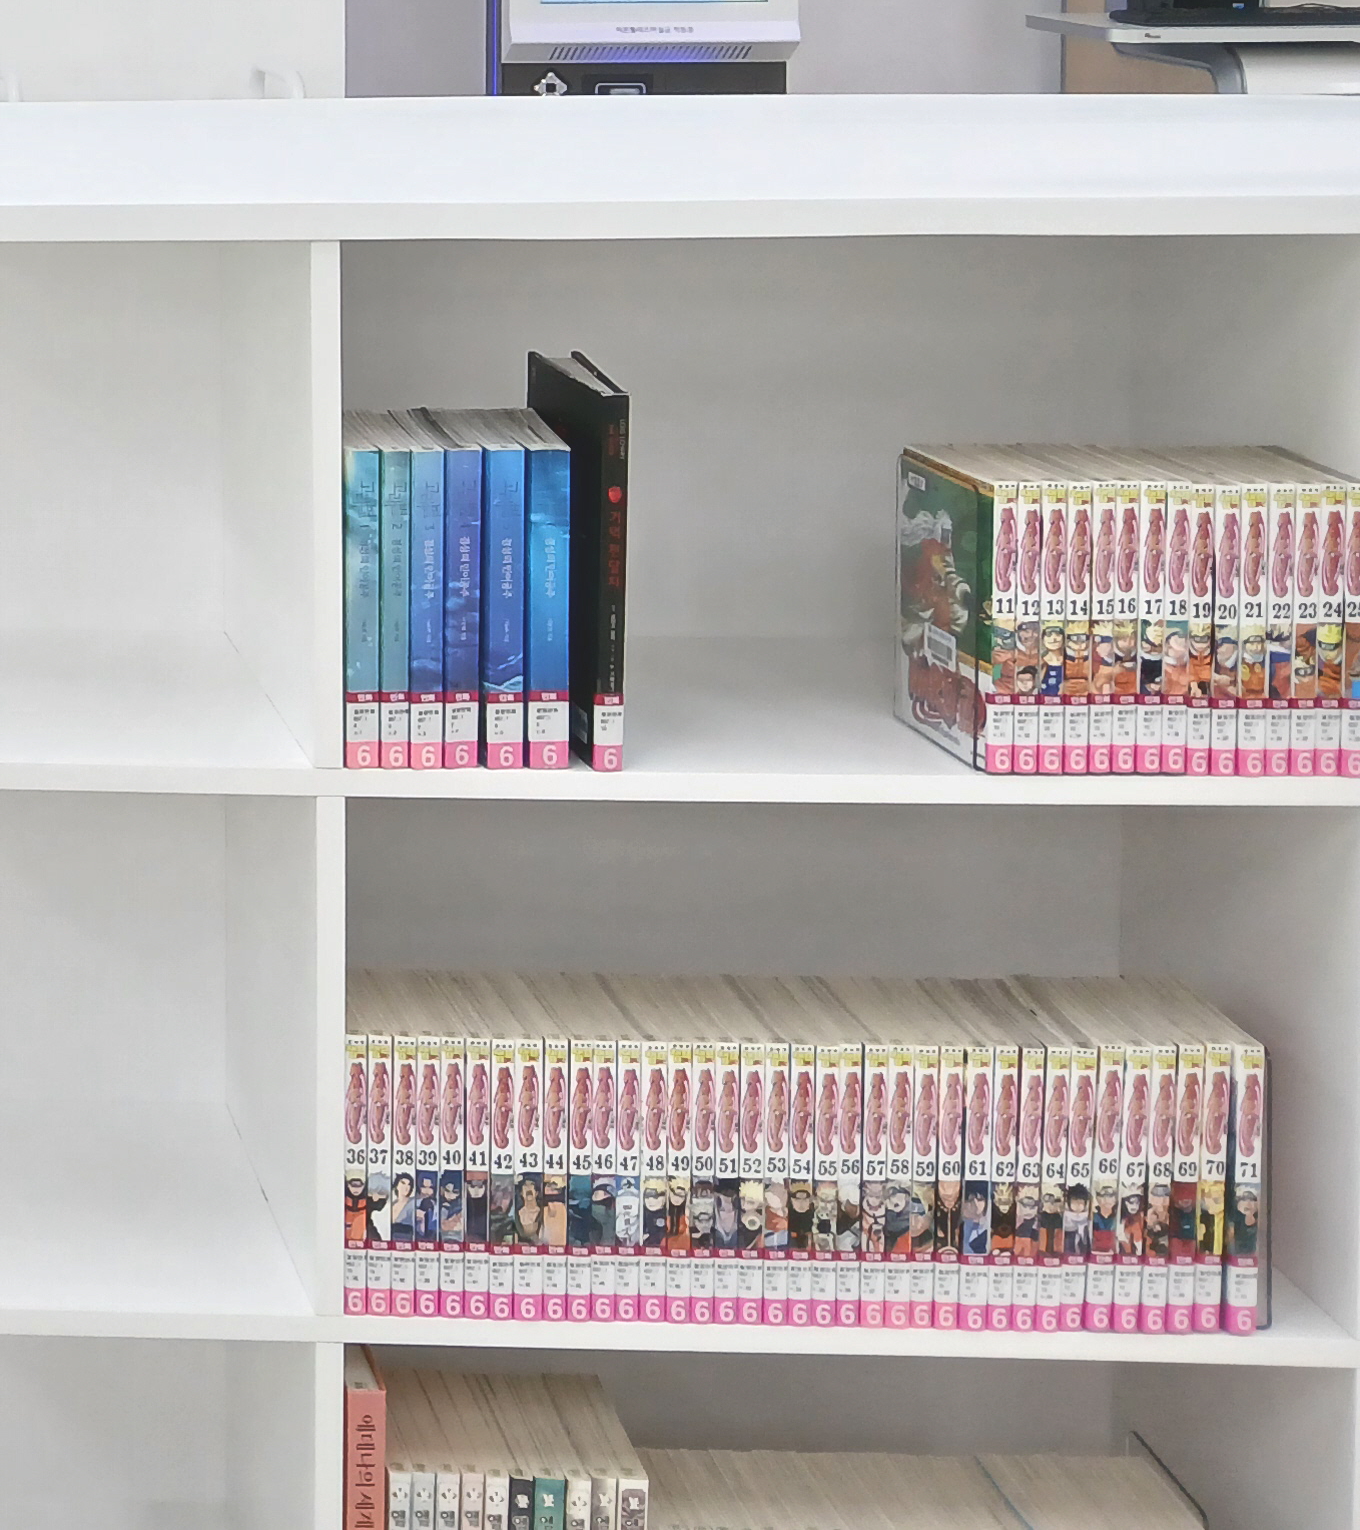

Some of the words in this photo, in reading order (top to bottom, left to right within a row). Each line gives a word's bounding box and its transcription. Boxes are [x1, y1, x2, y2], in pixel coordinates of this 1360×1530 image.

[996, 598, 1013, 613] 11
[1021, 600, 1040, 615] 12
[1046, 599, 1064, 614] 13
[1070, 600, 1088, 615] 14
[1097, 599, 1114, 614] 15
[1118, 598, 1136, 613] 16
[1145, 600, 1163, 615] 17
[1169, 600, 1187, 615] 18
[1192, 603, 1211, 618] 19
[1218, 604, 1237, 619] 20
[1245, 602, 1264, 617] 21
[1272, 603, 1291, 618] 22
[1298, 603, 1317, 618] 23
[1322, 602, 1342, 617] 24
[357, 745, 371, 766] 6
[500, 746, 514, 766] 6
[346, 1149, 365, 1164] 36
[395, 1150, 414, 1165] 38
[442, 1150, 461, 1165] 40
[493, 1154, 513, 1169] 42
[546, 1154, 565, 1169] 44
[594, 1154, 614, 1169] 46
[645, 1156, 665, 1171] 48
[694, 1157, 714, 1172] 50
[742, 1158, 762, 1173] 52
[792, 1160, 811, 1175] 54
[840, 1160, 860, 1175] 56
[890, 1160, 909, 1175] 58
[942, 1161, 960, 1176] 60
[995, 1162, 1015, 1177] 62
[1046, 1163, 1064, 1178] 64
[1098, 1159, 1117, 1174] 66
[1153, 1163, 1172, 1178] 68
[1205, 1161, 1225, 1176] 70
[355, 1414, 377, 1487] 에데나의
